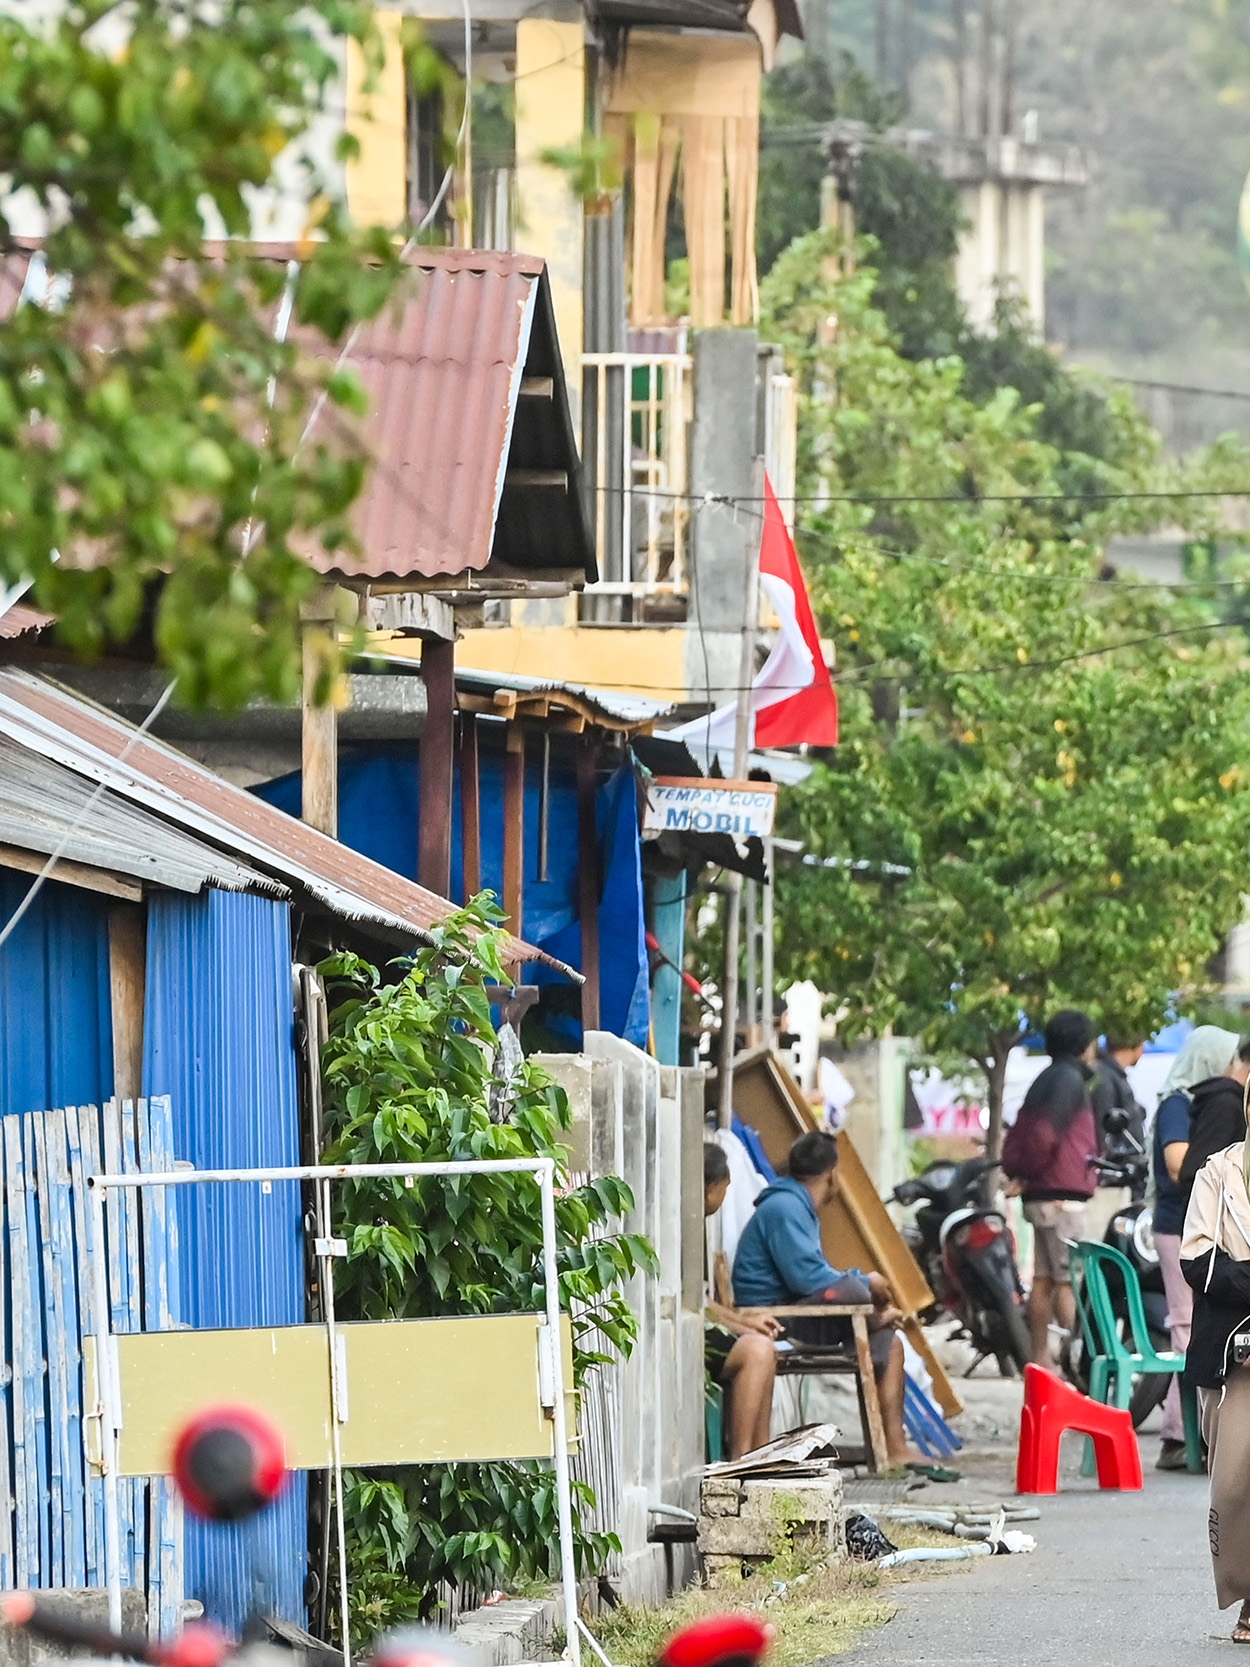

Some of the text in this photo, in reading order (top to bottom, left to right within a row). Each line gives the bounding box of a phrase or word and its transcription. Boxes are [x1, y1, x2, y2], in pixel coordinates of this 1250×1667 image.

[655, 788, 772, 809] TEMPAT CUCI
[666, 807, 759, 837] MOBIL
